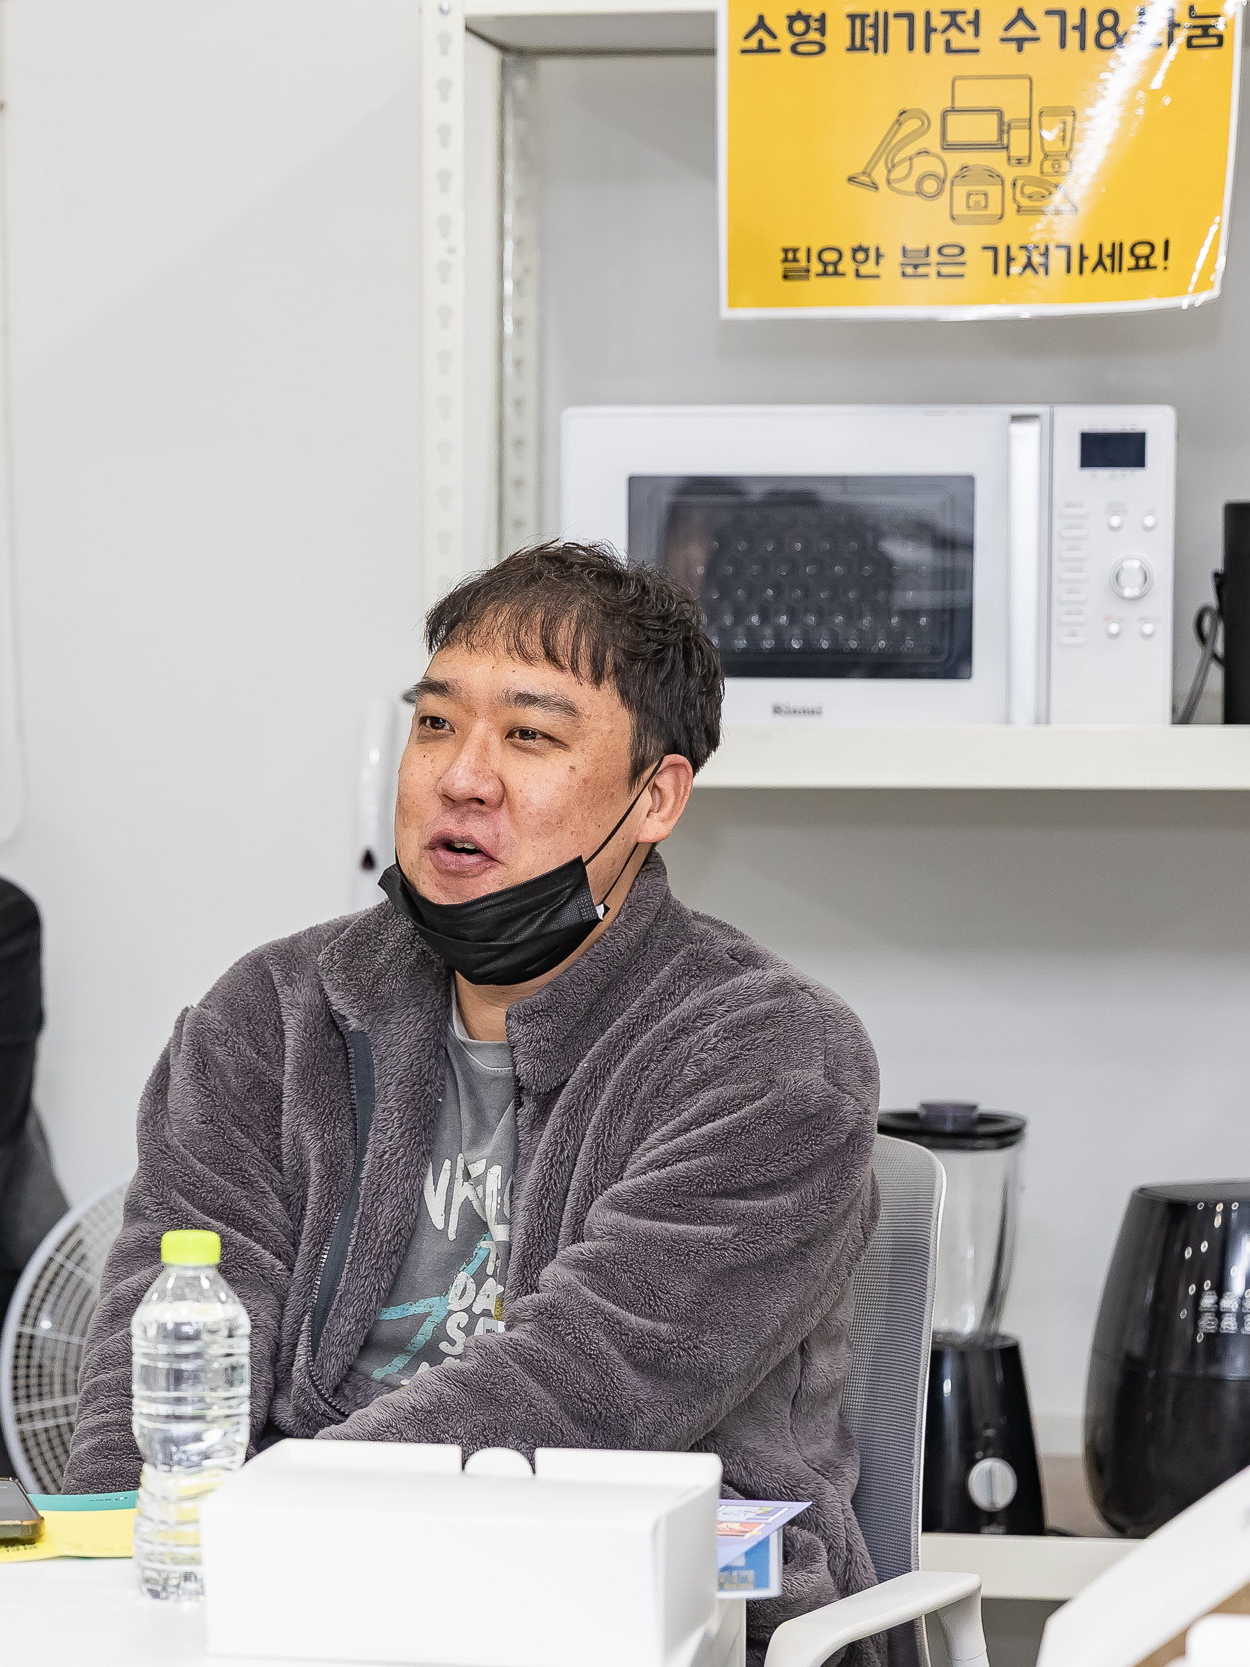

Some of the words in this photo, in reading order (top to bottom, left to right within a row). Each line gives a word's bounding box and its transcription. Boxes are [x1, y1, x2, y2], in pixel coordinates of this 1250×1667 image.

[740, 10, 827, 56] 소형
[846, 9, 980, 54] 폐가전
[781, 244, 884, 281] 필요한
[901, 244, 966, 278] 분은
[982, 238, 1170, 277] 가져가세요!
